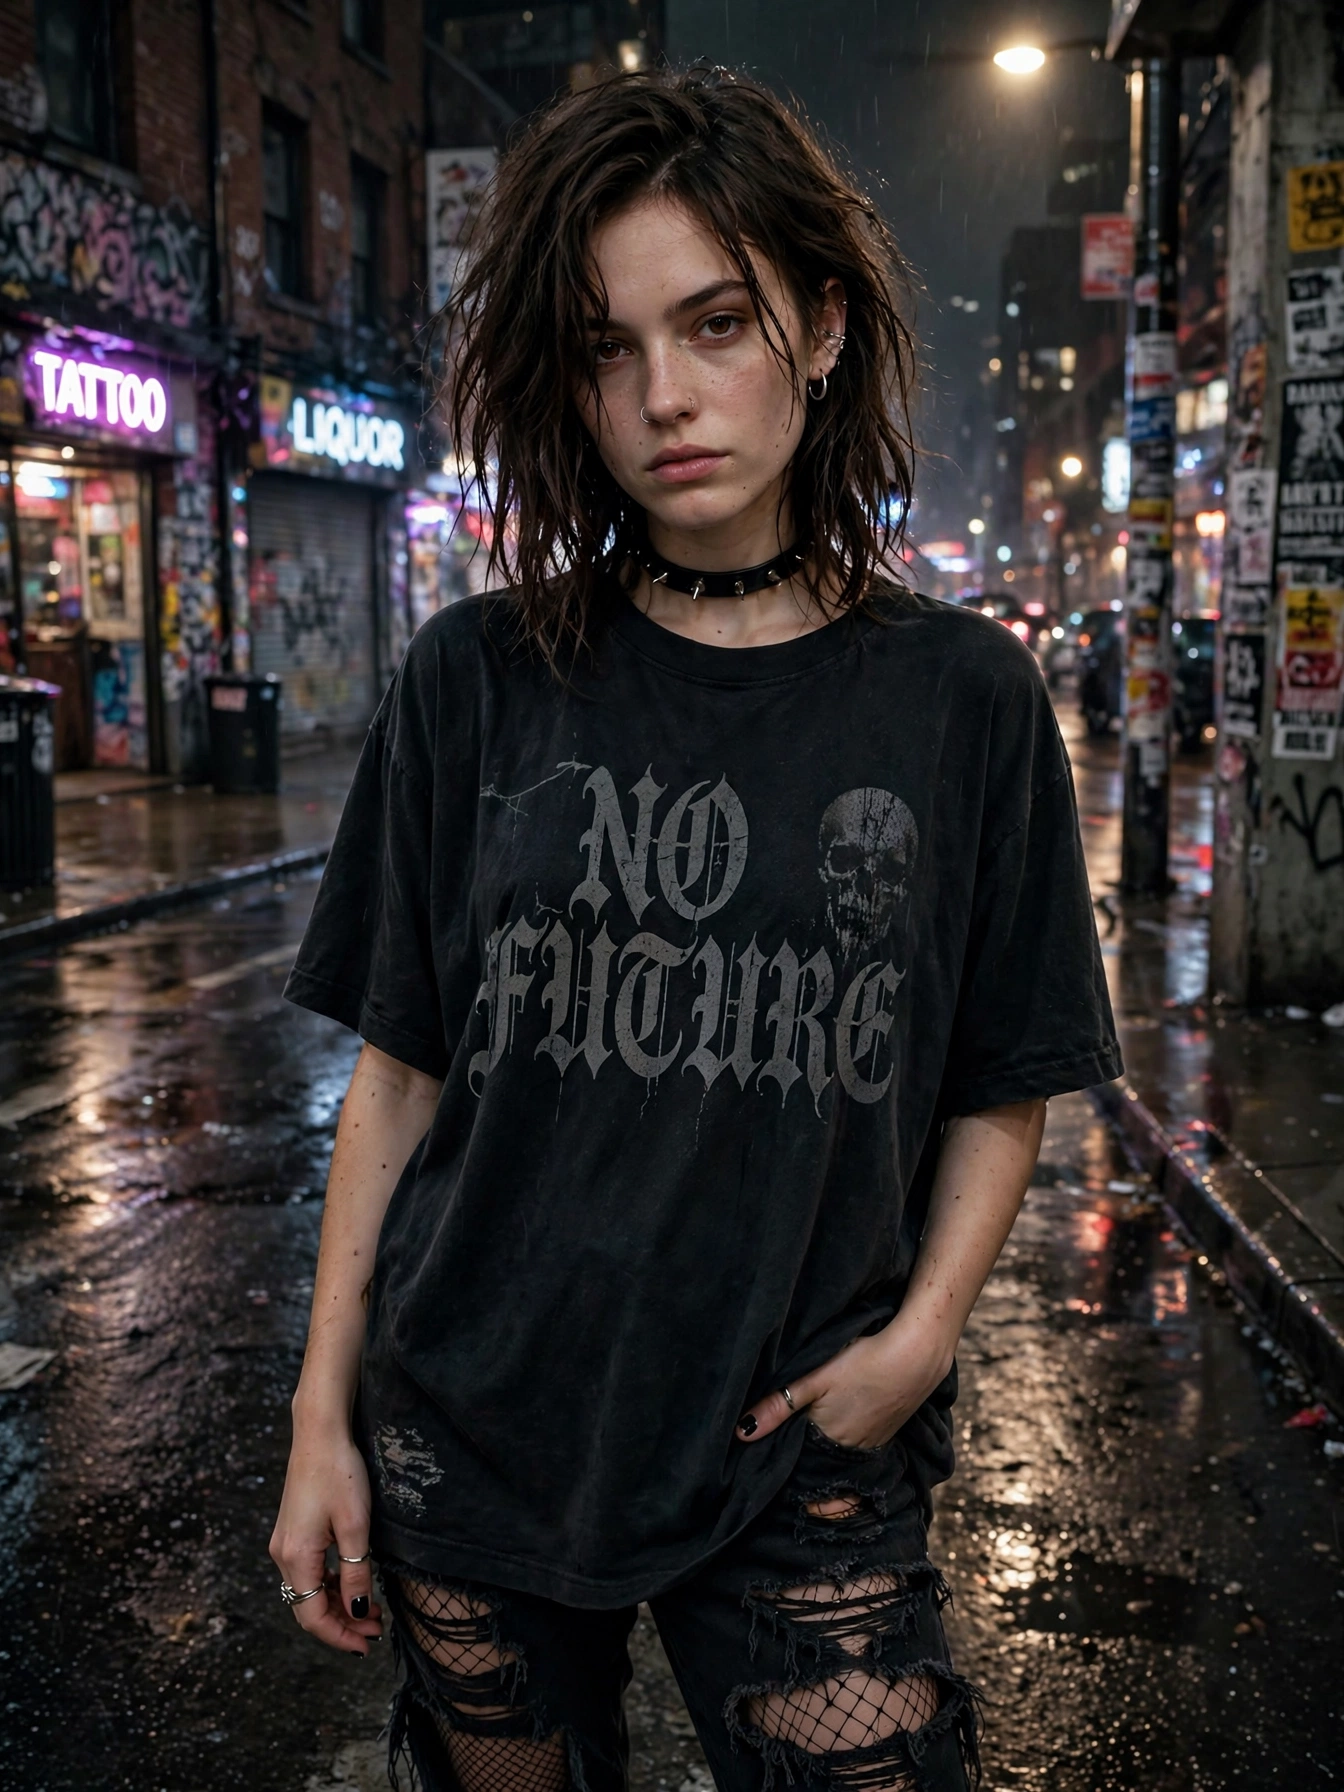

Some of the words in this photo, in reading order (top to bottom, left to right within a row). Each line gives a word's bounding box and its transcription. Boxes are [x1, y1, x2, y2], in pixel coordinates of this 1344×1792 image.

[34, 351, 167, 432] TATTOO
[293, 397, 404, 471] LIQUOR
[569, 763, 749, 925] NO
[468, 915, 906, 1112] FUTURE
